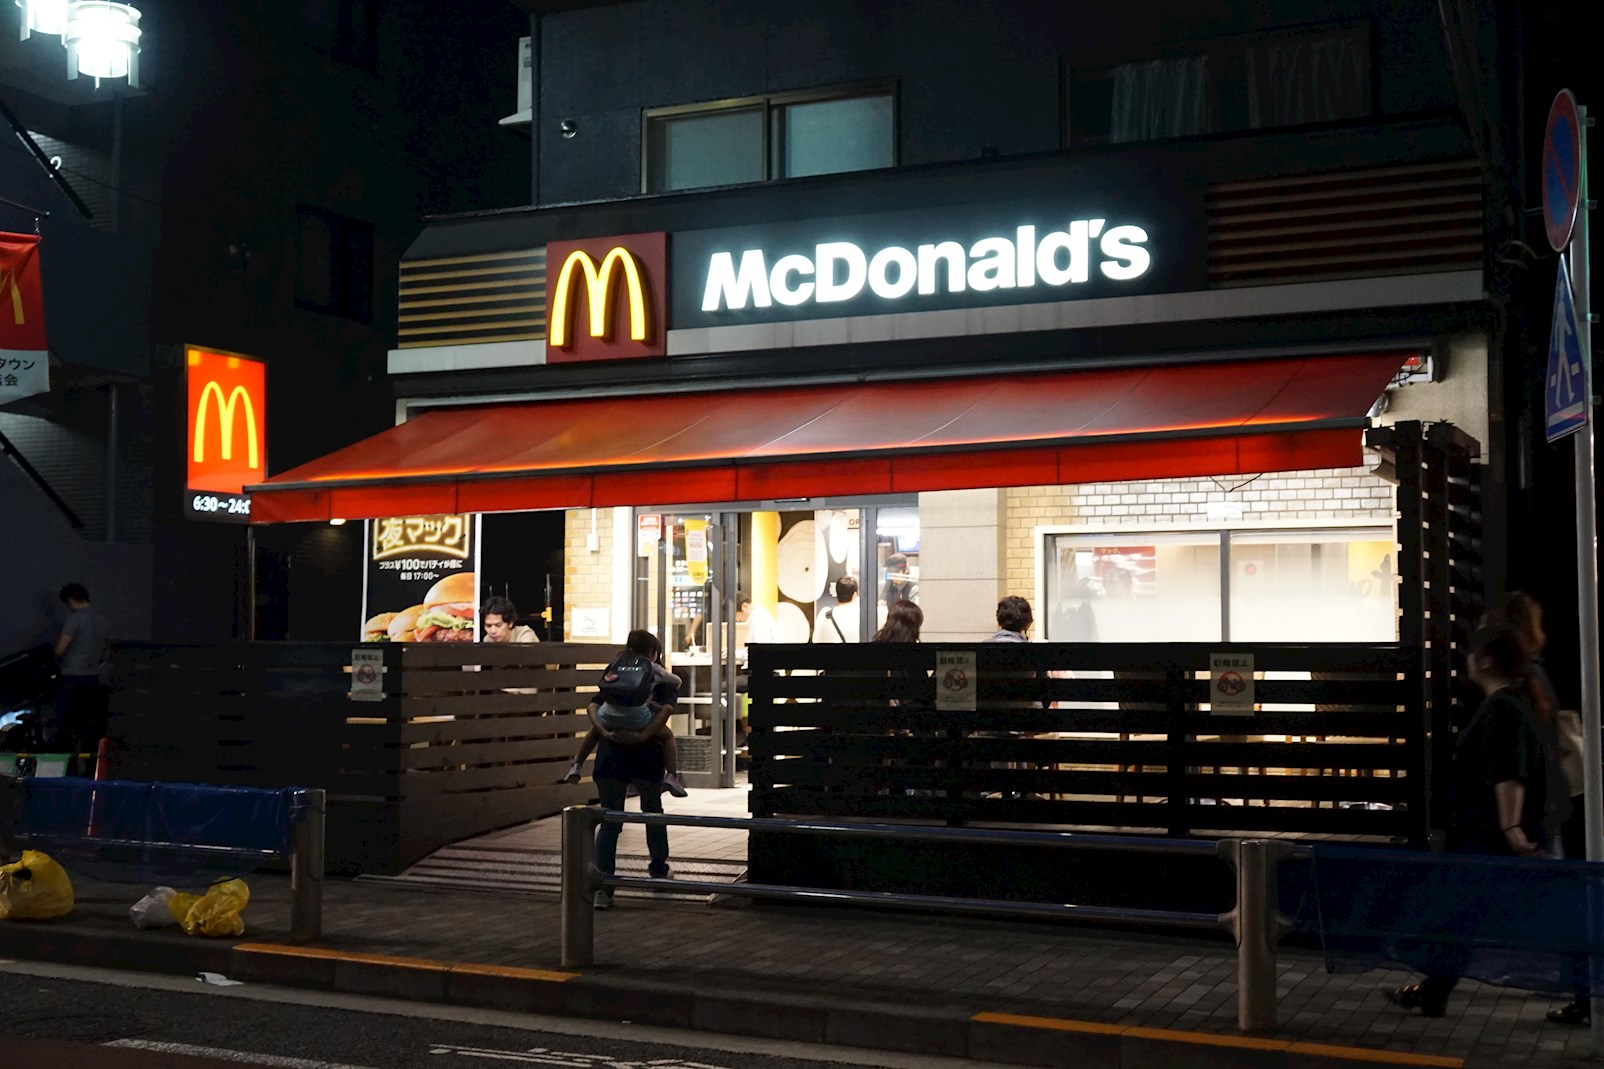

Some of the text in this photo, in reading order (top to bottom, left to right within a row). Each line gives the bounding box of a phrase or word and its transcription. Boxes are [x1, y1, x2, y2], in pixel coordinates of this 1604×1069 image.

[701, 218, 1151, 312] McDonald's
[379, 516, 463, 551] 夜マック
